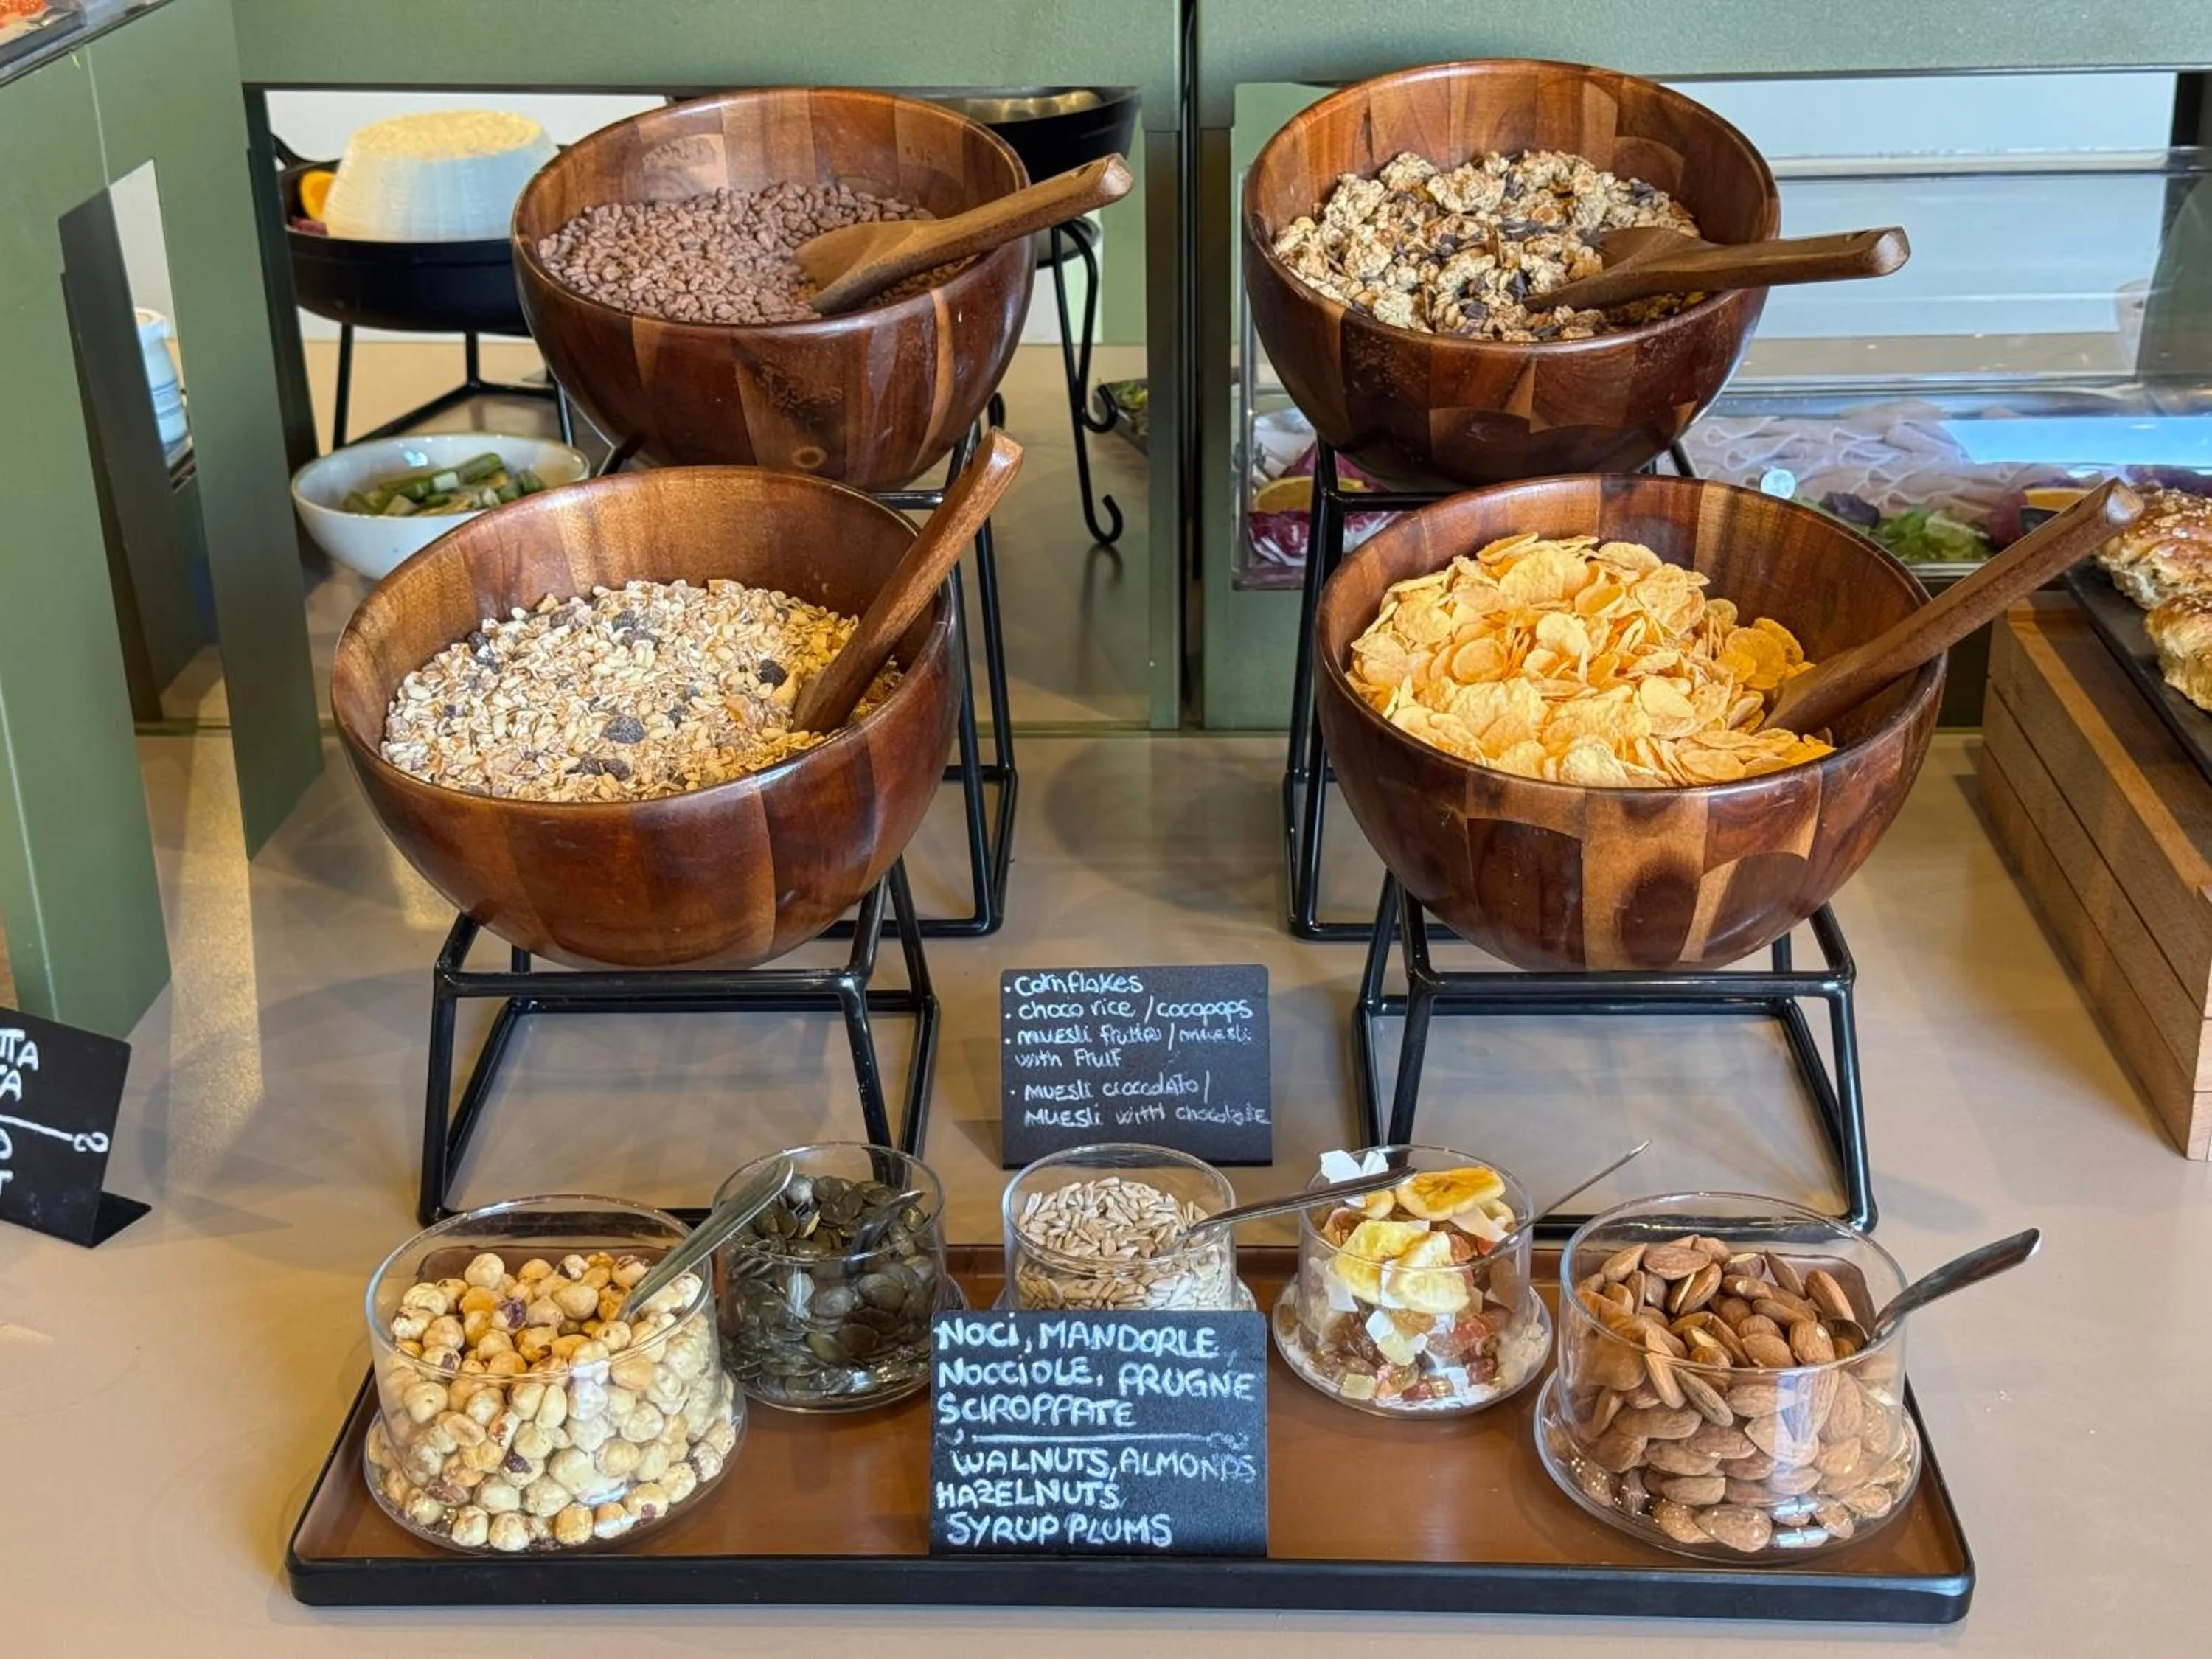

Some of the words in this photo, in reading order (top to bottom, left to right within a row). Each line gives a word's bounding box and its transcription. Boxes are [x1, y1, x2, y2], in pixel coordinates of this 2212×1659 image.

[1018, 1001, 1084, 1020] choco
[1091, 998, 1136, 1018] rice
[1118, 1361, 1256, 1401] PRUGNE
[947, 1512, 1060, 1547] SYRUP
[1065, 1514, 1172, 1548] PLUMS
